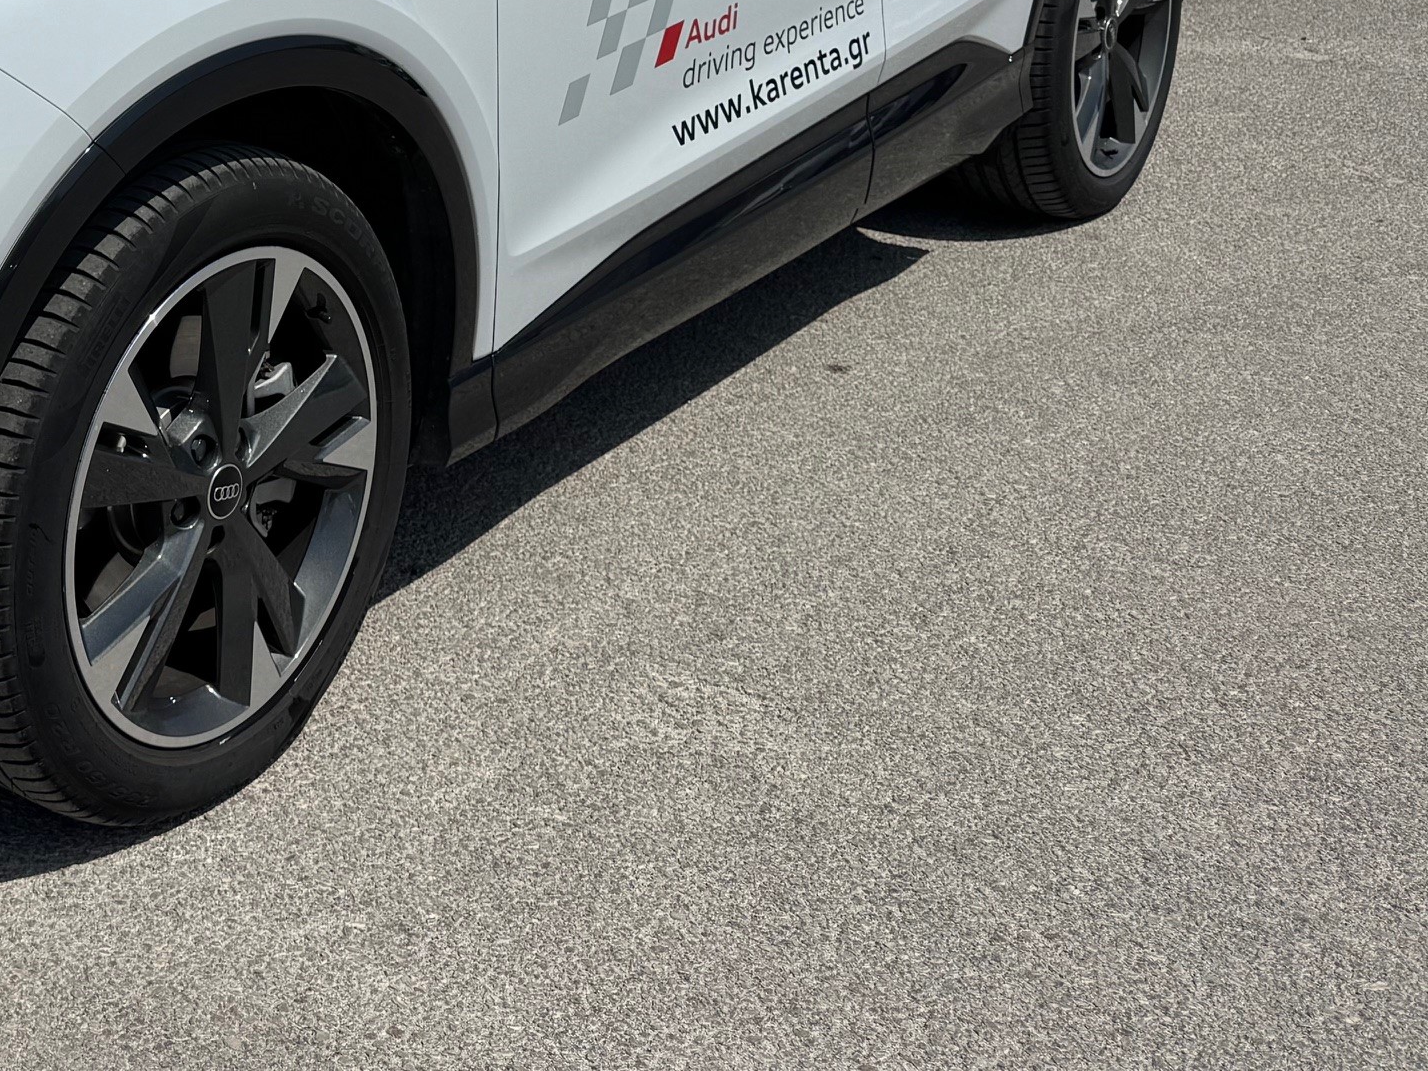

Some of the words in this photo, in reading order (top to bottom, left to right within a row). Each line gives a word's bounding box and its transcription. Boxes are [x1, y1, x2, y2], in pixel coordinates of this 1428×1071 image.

[684, 2, 739, 50] Audi
[671, 28, 871, 147] www.karenta.gr
[682, 39, 757, 89] driving
